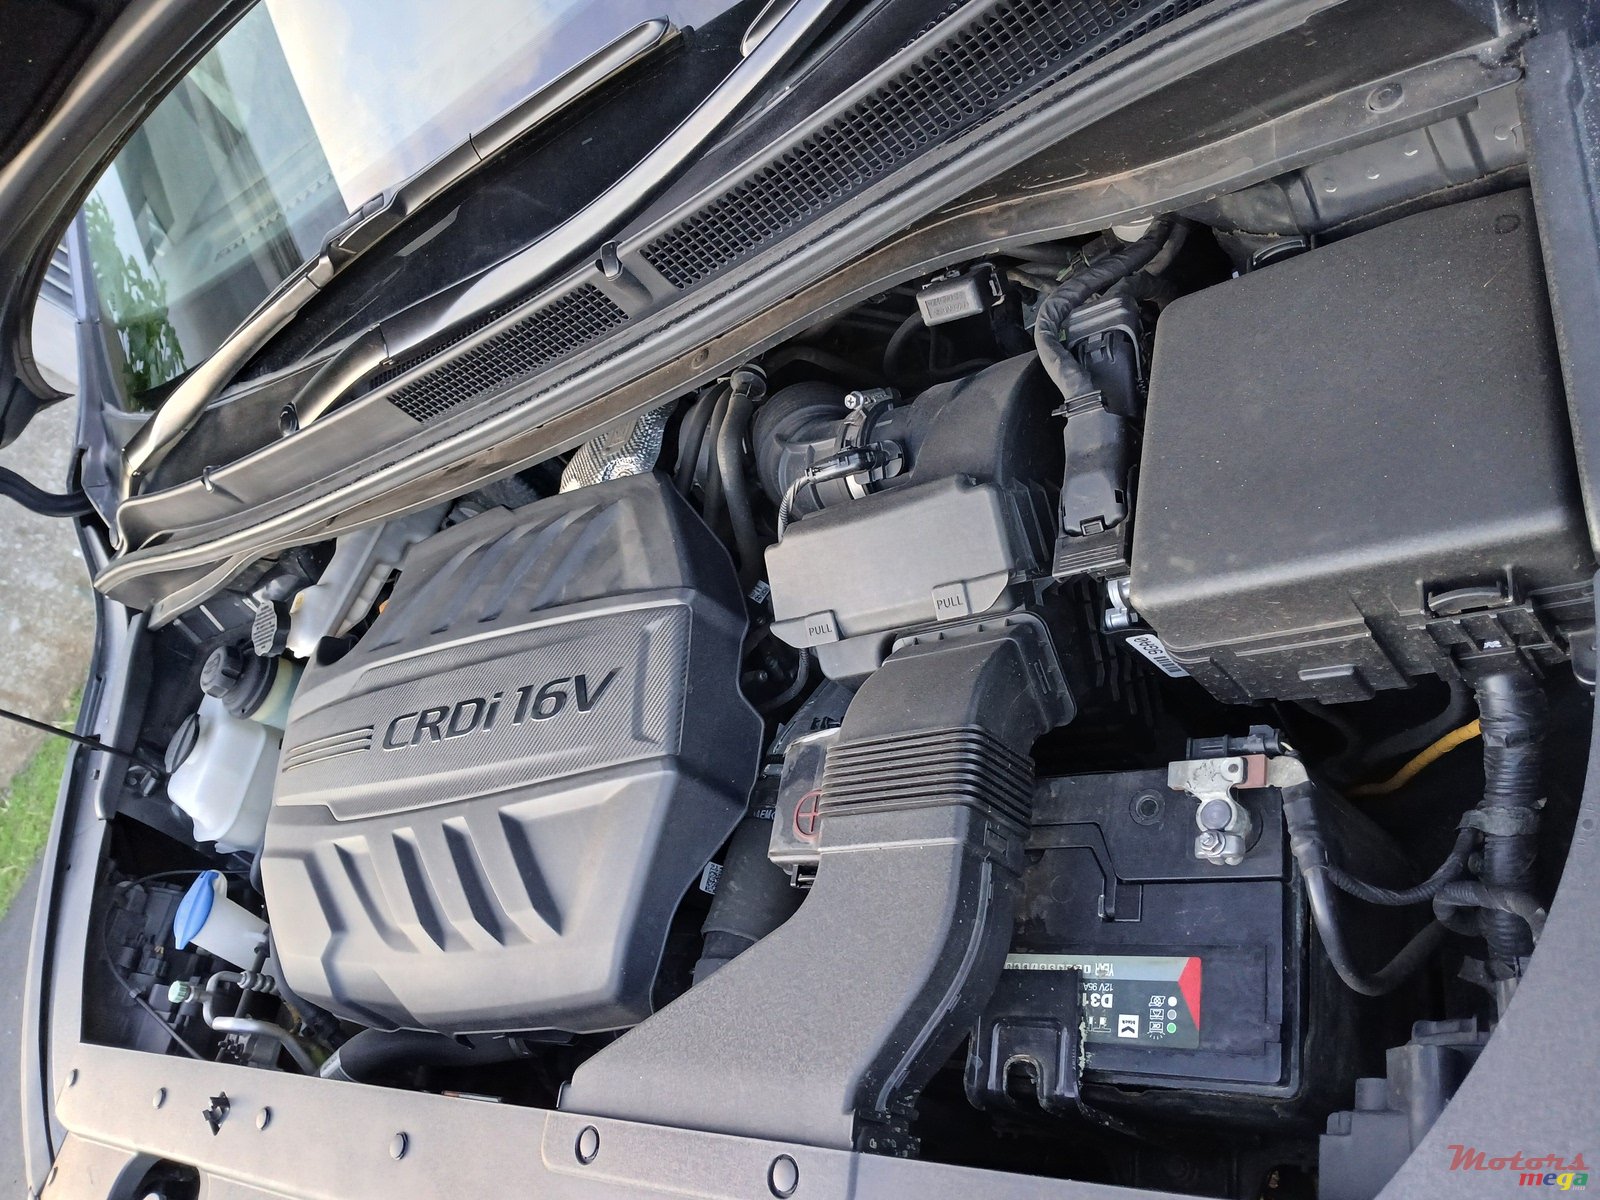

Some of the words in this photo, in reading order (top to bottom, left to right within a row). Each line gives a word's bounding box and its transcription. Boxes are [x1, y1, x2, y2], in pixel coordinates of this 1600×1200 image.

[936, 595, 964, 610] PULL
[808, 623, 833, 636] PULL
[382, 691, 504, 752] CRDi
[512, 667, 623, 726] 16V
[1095, 963, 1114, 977] YEAR
[1082, 982, 1097, 991] 95A
[1098, 982, 1114, 992] 12V
[1081, 993, 1113, 1009] D31
